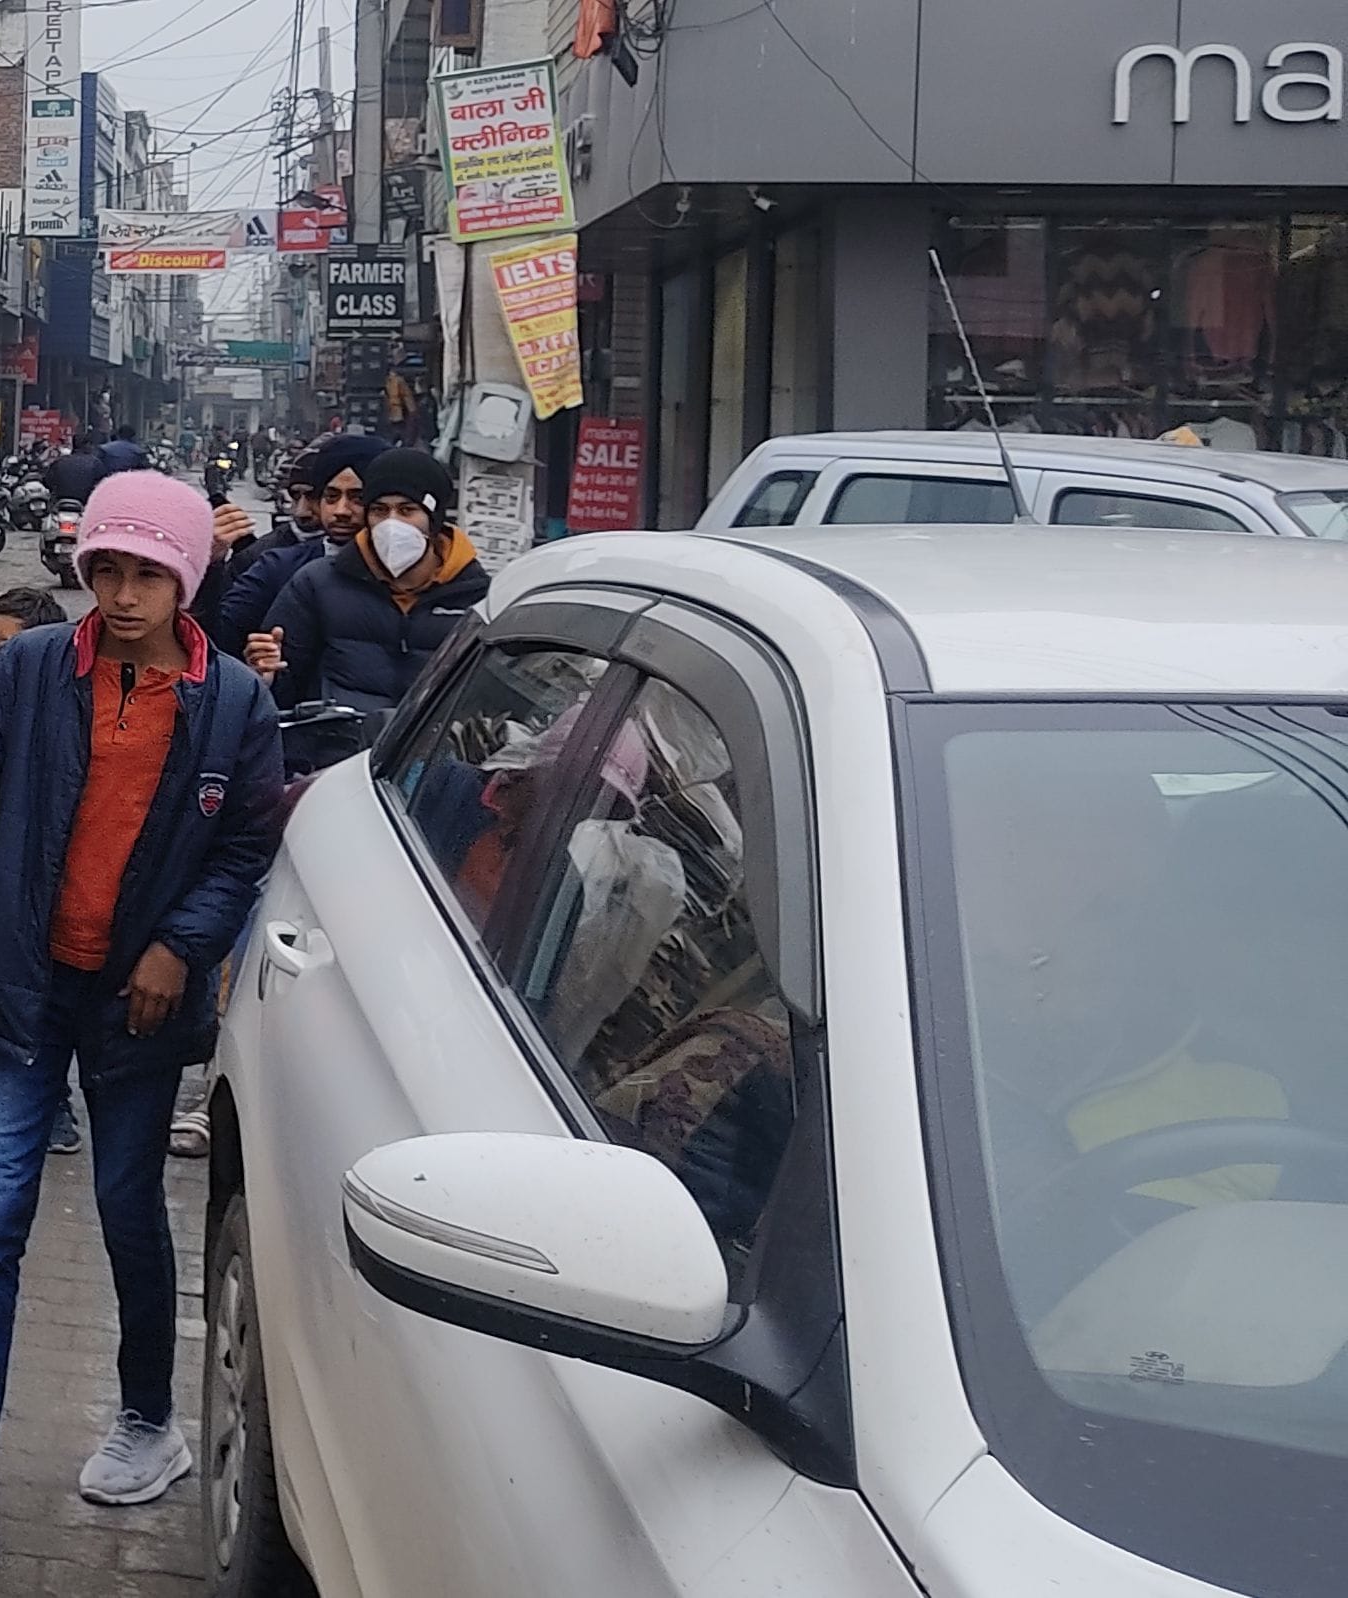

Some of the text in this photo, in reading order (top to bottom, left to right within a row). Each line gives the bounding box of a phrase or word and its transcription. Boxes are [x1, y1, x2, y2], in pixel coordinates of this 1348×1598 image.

[1114, 41, 1343, 123] ma
[138, 254, 210, 268] Discount
[329, 262, 404, 284] FARMER
[502, 251, 576, 287] IELTS
[335, 294, 396, 316] CLASS
[576, 441, 640, 468] SALE
